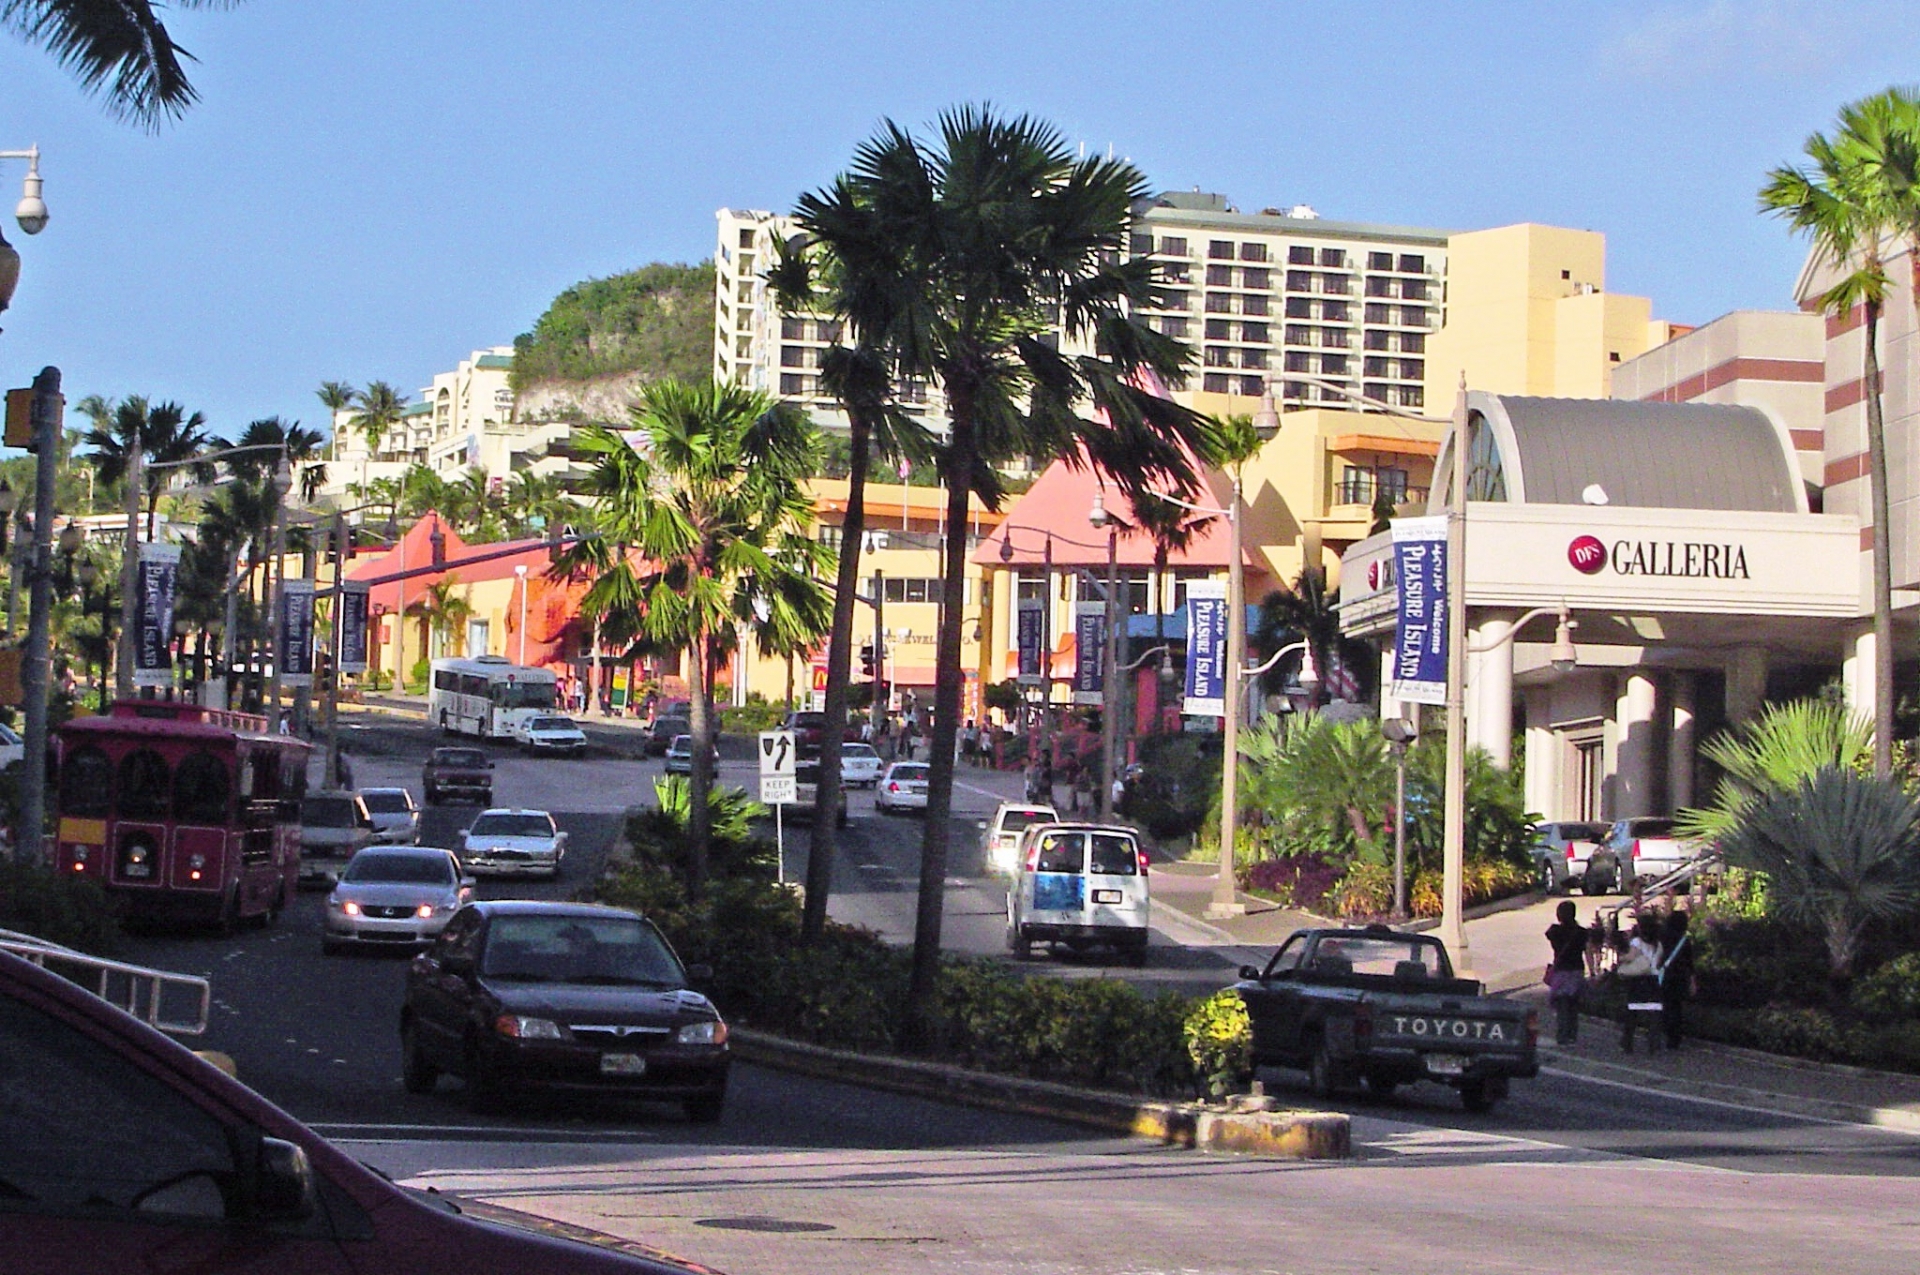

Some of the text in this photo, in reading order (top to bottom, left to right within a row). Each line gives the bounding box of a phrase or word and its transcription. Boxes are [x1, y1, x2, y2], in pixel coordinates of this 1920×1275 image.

[1574, 539, 1751, 580] DFS GALLERIA
[1402, 544, 1427, 618] PLEASURE
[143, 625, 159, 667] ISLAND
[1195, 600, 1214, 654] PLEASURE
[1431, 599, 1445, 655] Welcome
[1400, 622, 1428, 678] ISLAND
[1194, 657, 1213, 697] ISLAND
[764, 790, 792, 799] RIGHT
[765, 780, 791, 789] KEEP
[1394, 1016, 1504, 1040] TOYOTA
